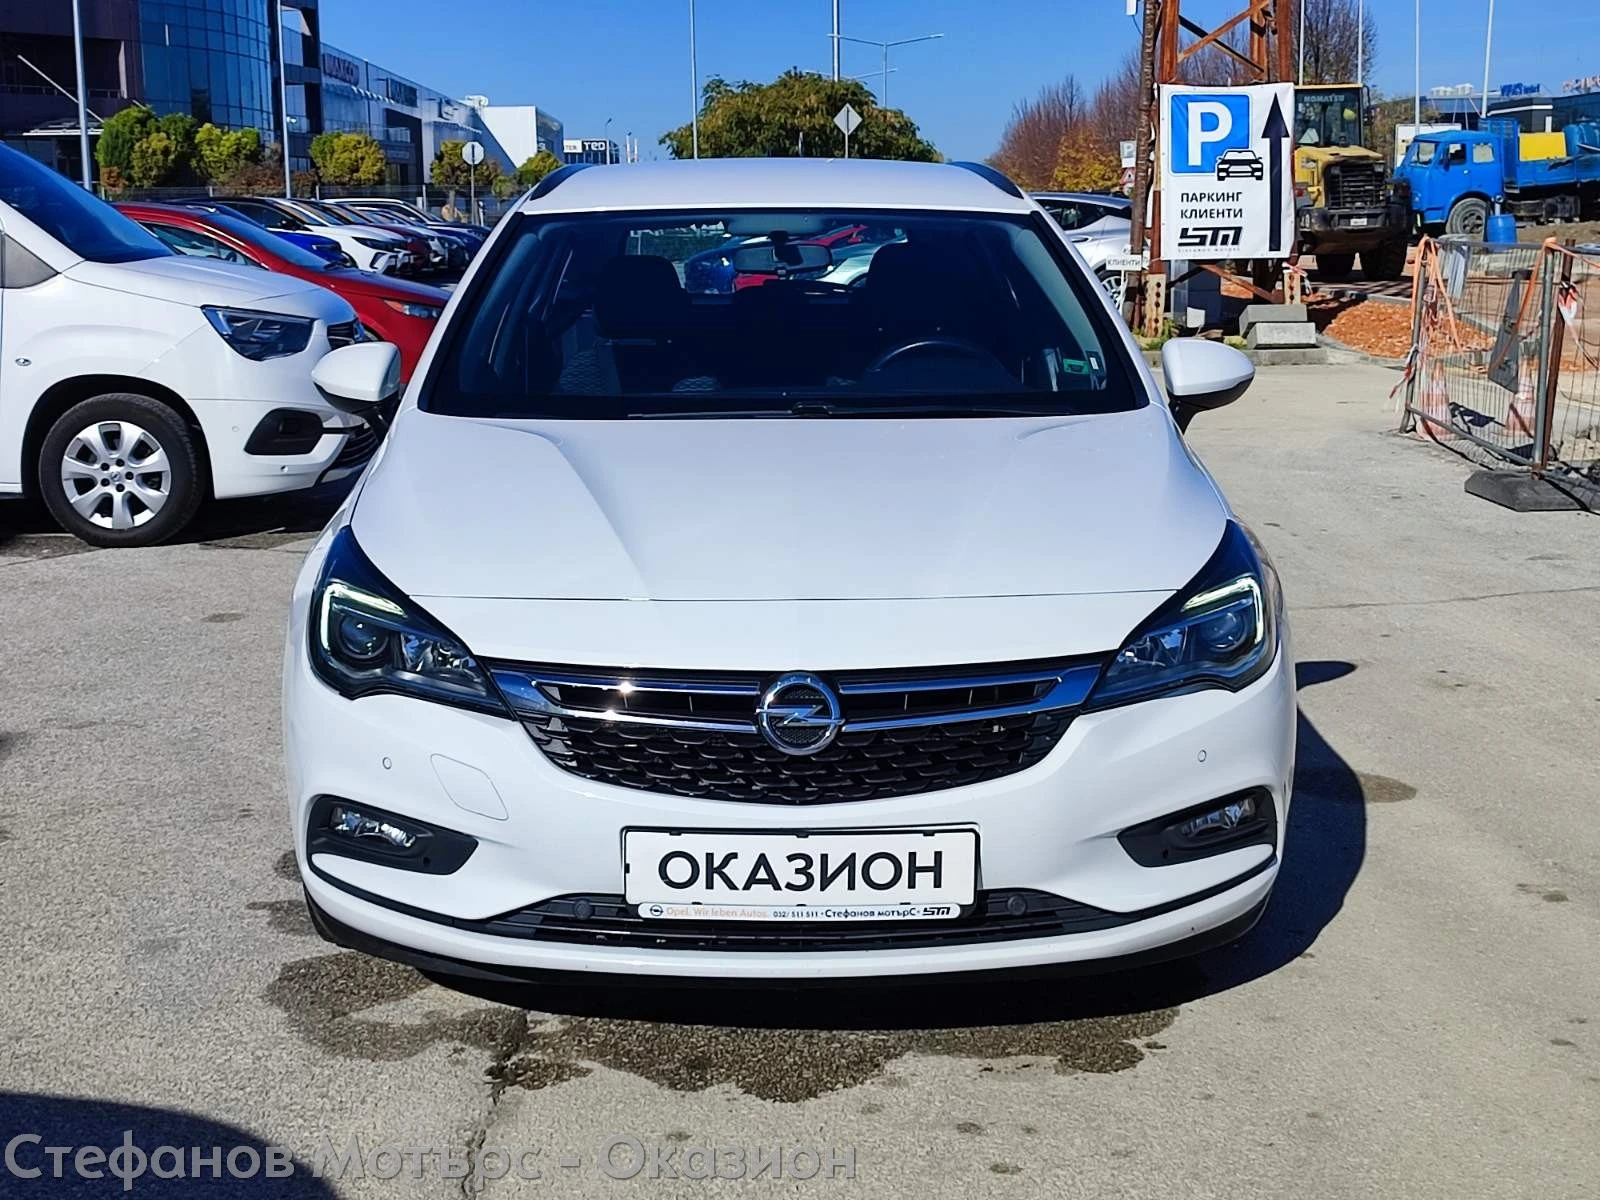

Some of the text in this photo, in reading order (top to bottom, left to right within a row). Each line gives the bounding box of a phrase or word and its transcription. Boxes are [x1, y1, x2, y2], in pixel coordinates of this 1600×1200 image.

[1303, 95, 1345, 103] KOMATSU
[1187, 101, 1233, 166] P
[1180, 192, 1243, 203] ПАРКИНГ
[1180, 208, 1243, 219] КЛИЕНТИ
[658, 850, 943, 892] ОКАЗИОН
[712, 908, 737, 917] leben
